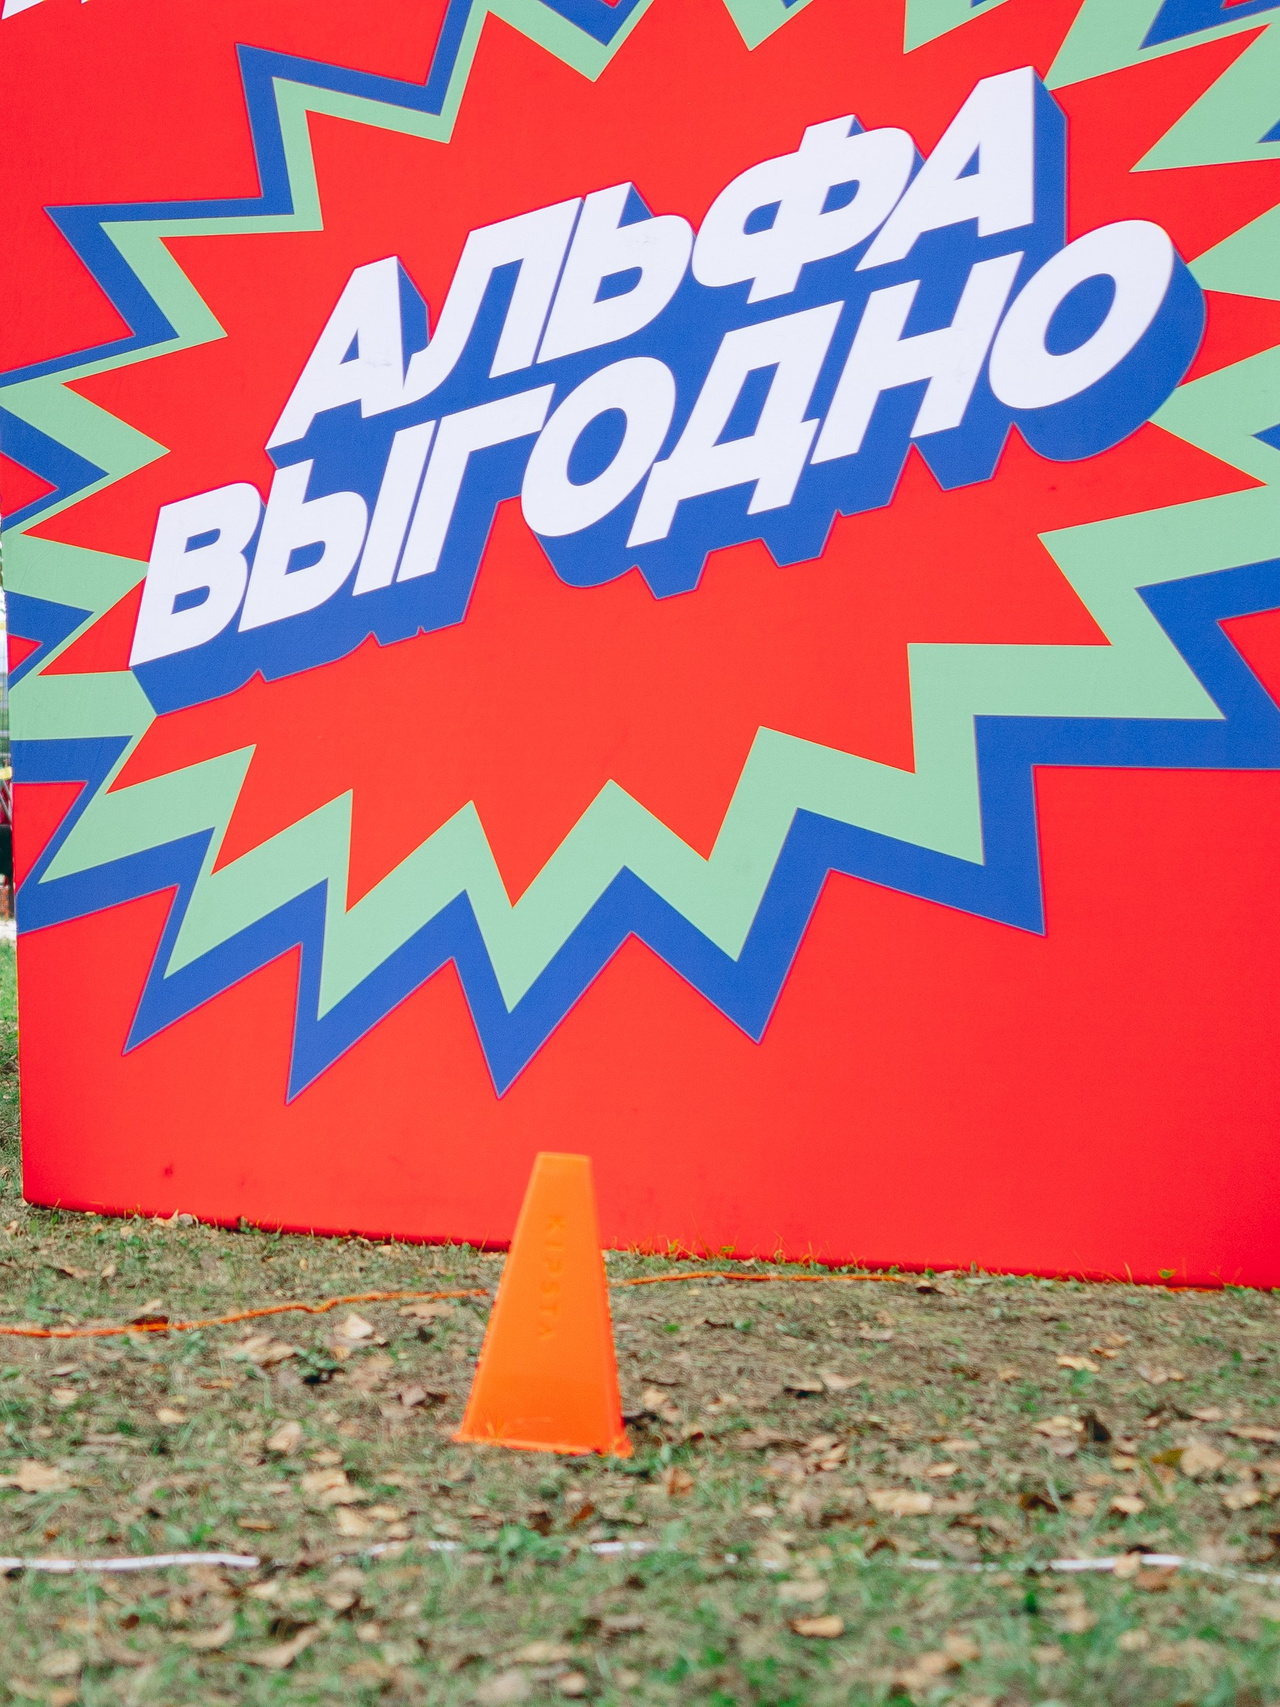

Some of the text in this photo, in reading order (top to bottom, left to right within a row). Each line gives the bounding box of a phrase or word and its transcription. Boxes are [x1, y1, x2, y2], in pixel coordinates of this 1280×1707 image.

[128, 219, 1174, 667] ВЫГОДНО
[265, 65, 1034, 450] АЛЬФА
[539, 1214, 566, 1341] KIPSTA
